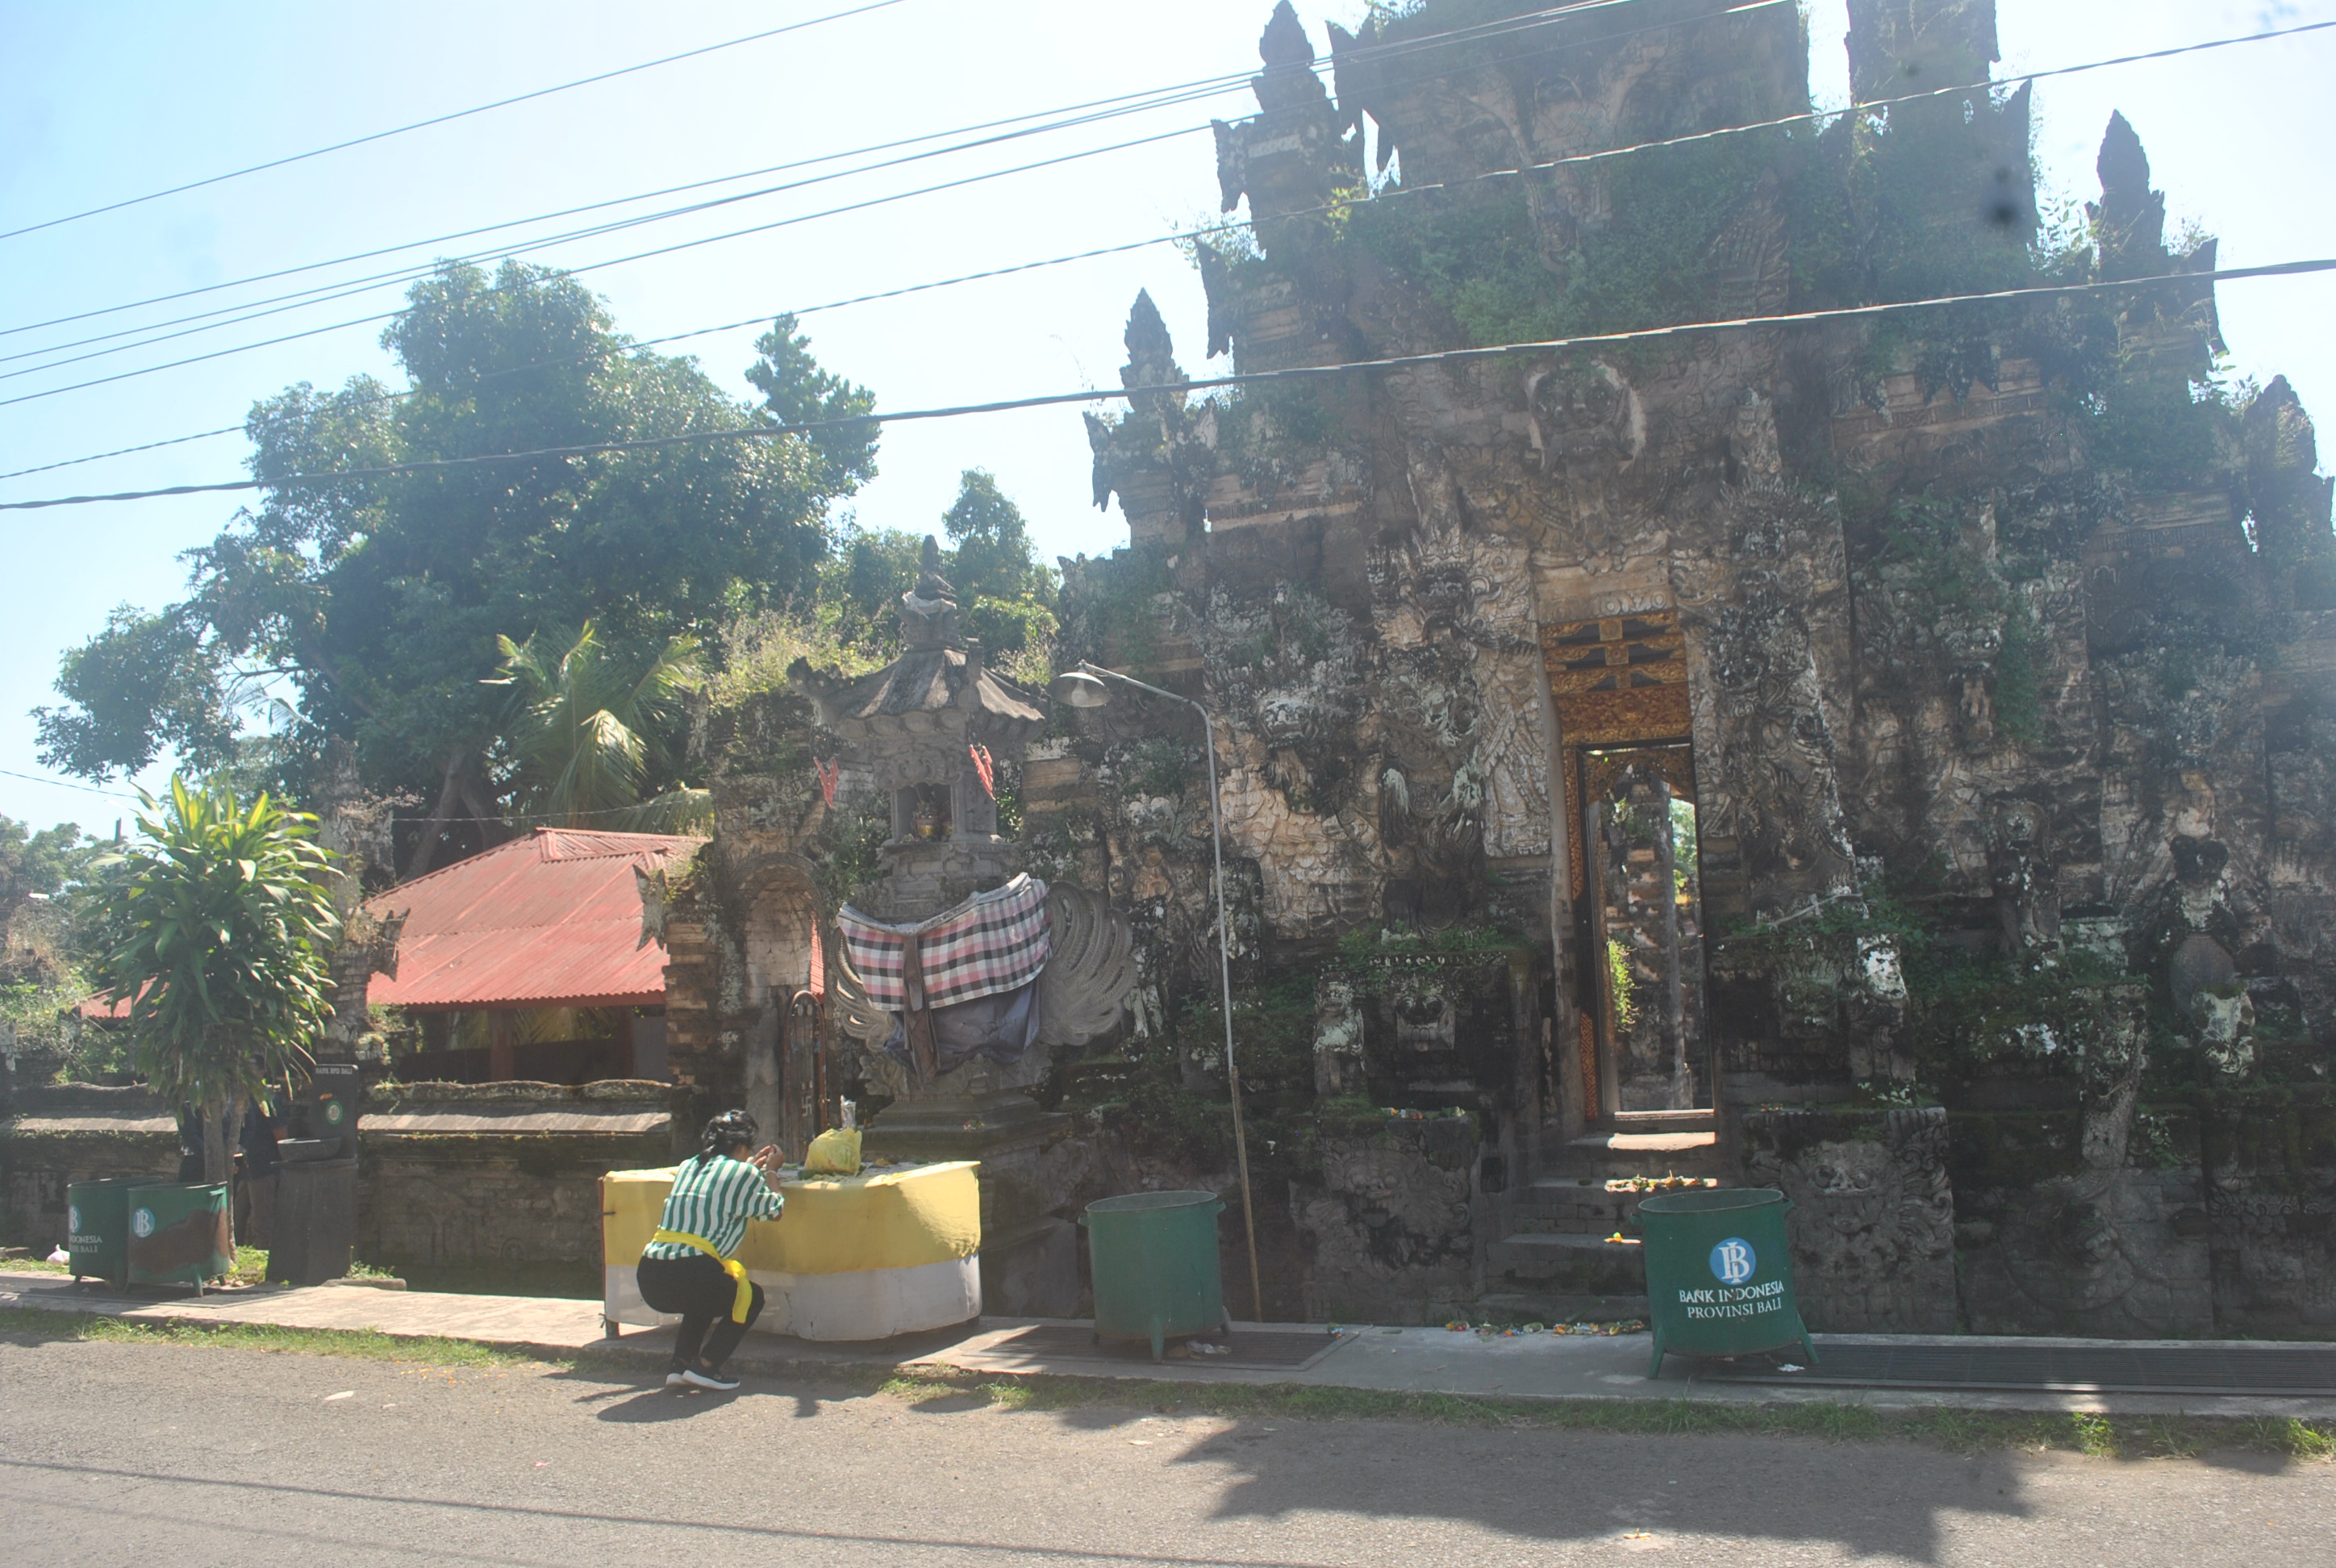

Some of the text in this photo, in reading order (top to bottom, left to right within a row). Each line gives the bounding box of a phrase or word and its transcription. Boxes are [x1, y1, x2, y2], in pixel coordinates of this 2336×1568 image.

[340, 1067, 352, 1075] BALI
[1679, 1280, 1785, 1303] BANK INDONESIA
[1687, 1297, 1782, 1319] PROVINSI BALI
